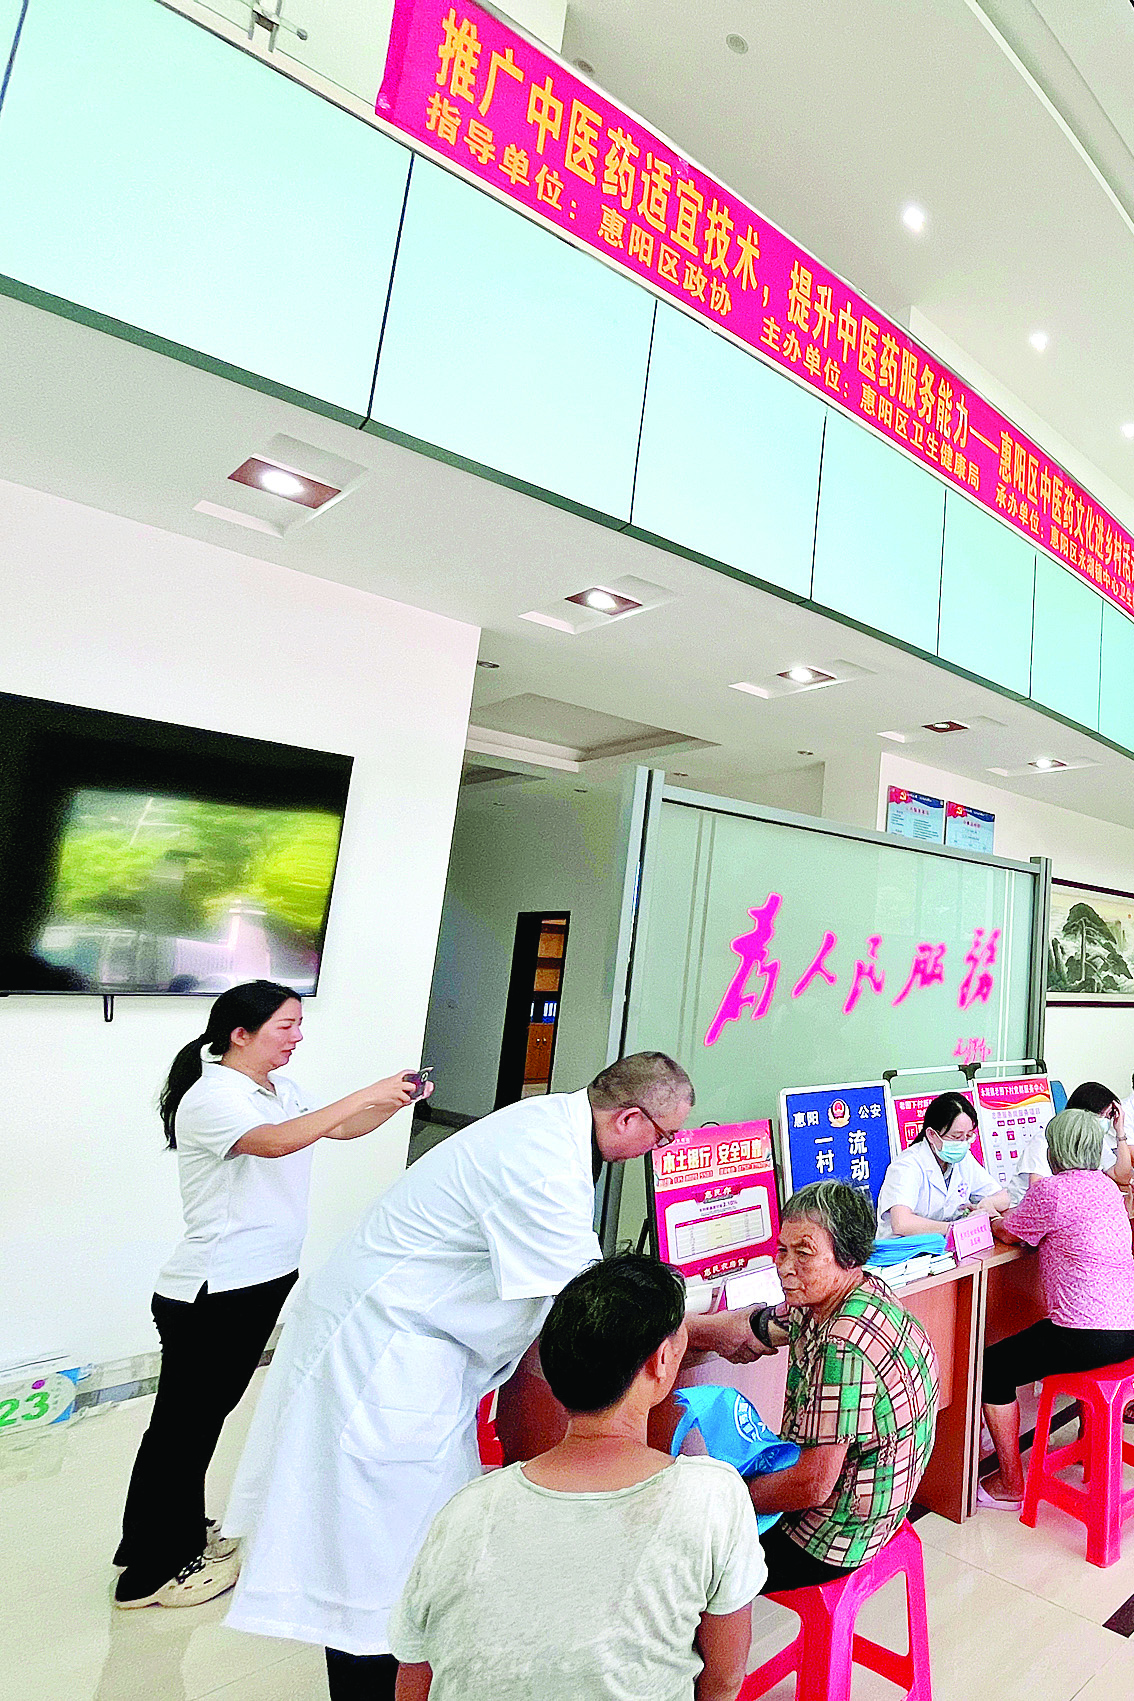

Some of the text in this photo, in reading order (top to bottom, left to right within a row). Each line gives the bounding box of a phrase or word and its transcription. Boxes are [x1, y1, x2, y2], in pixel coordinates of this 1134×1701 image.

[425, 91, 733, 317] 指导单位：惠阳区政协
[759, 316, 981, 491] 主办单位：惠阳区卫生健康局
[792, 1102, 882, 1128] 惠阳 公安
